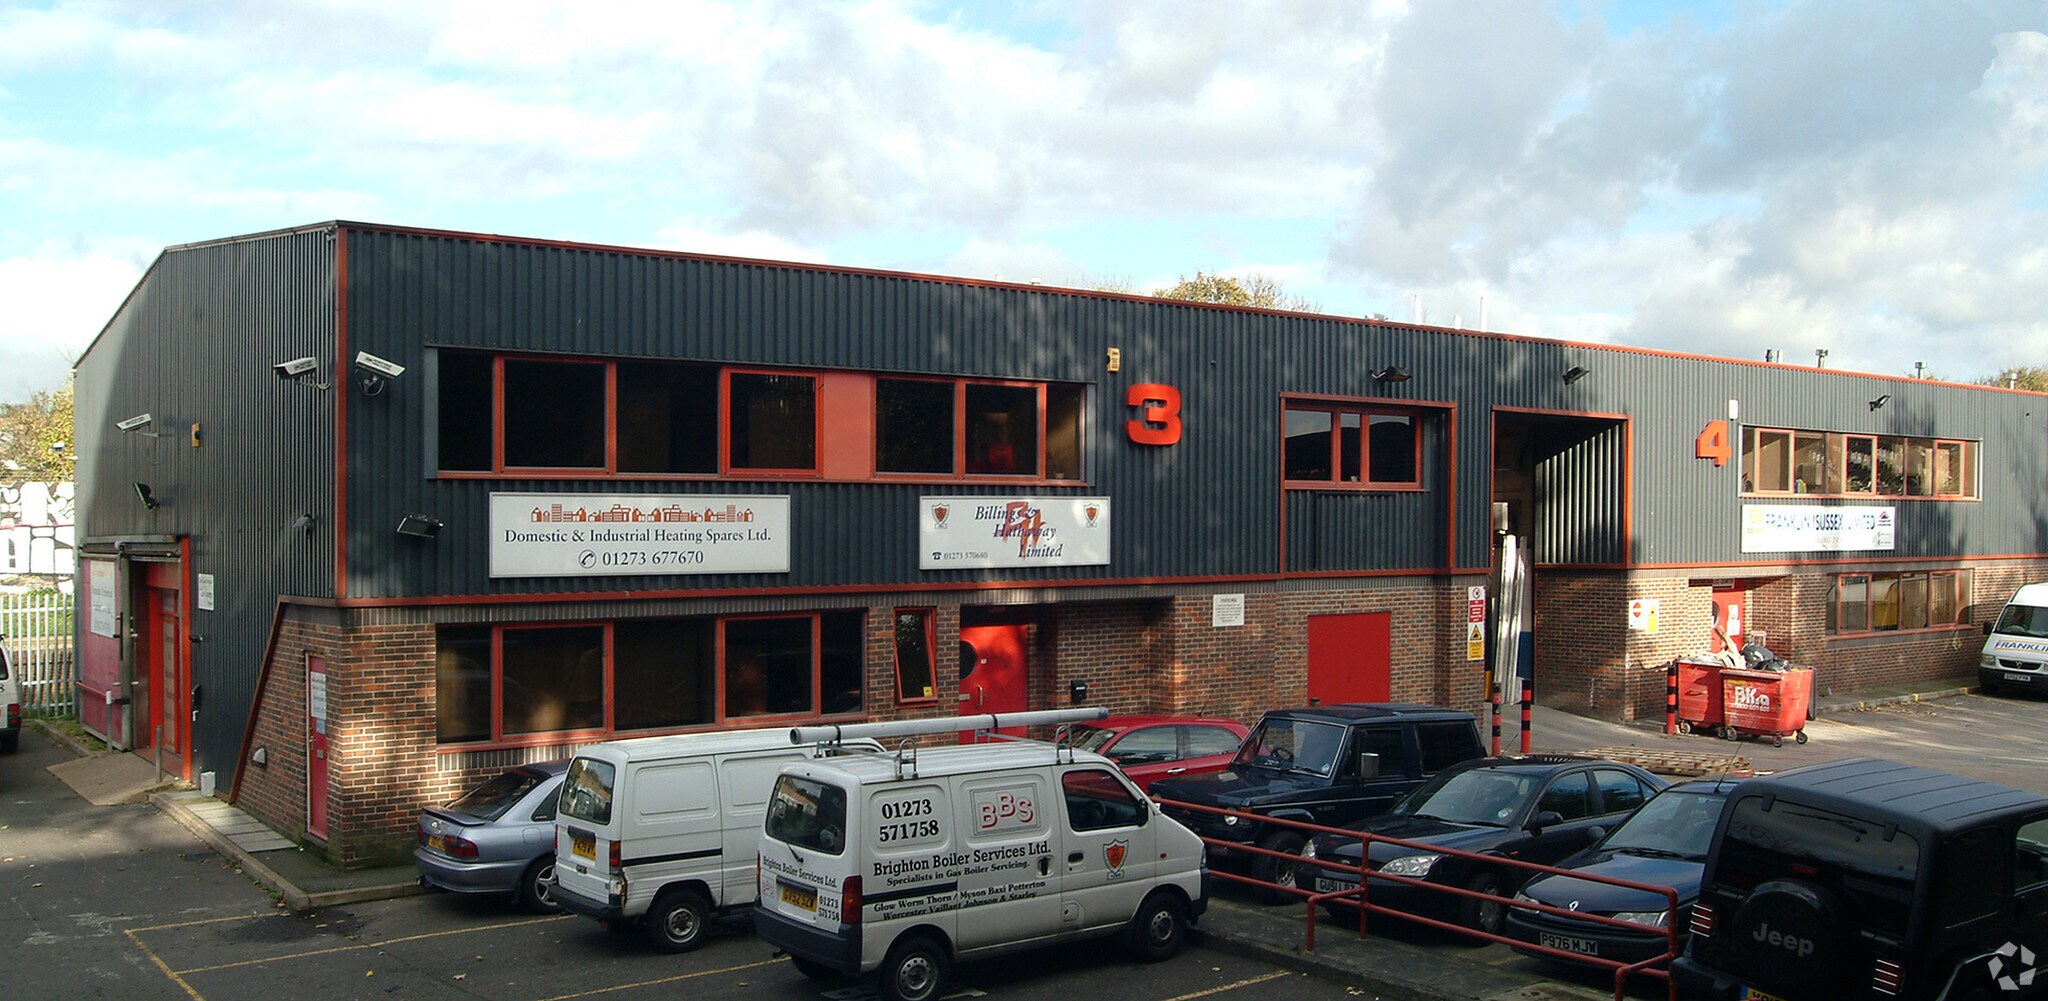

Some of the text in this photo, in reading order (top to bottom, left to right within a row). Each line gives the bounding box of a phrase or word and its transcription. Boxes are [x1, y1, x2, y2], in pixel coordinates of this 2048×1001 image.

[1125, 383, 1183, 446] 3
[1695, 419, 1733, 468] 4
[975, 505, 1040, 523] Billings &
[505, 528, 771, 545] Domestic & Industrial Heating Spares Ltd.
[993, 523, 1057, 541] Hathaway
[602, 550, 704, 566] 01273 677670
[1018, 543, 1064, 559] Limited
[881, 798, 932, 820] 01273
[977, 791, 1034, 829] BBS
[879, 819, 939, 842] 571758
[873, 840, 1051, 877] Brighton Boiler Services Ltd.
[886, 873, 933, 888] Specialists
[935, 871, 944, 880] in
[946, 869, 962, 879] Gas
[964, 866, 989, 876] Boiler
[819, 895, 839, 909] 01273
[874, 903, 896, 912] Glow
[898, 900, 924, 908] Worm
[927, 895, 952, 904] Thorn
[960, 890, 987, 899] Myson
[988, 885, 1006, 895] Baxi
[1008, 881, 1046, 892] Potterton
[883, 909, 927, 920] Worcester
[929, 903, 962, 914] Vaillant
[963, 898, 999, 908] Johnson
[1541, 933, 1570, 949] P976
[1753, 923, 1815, 957] Jeep
